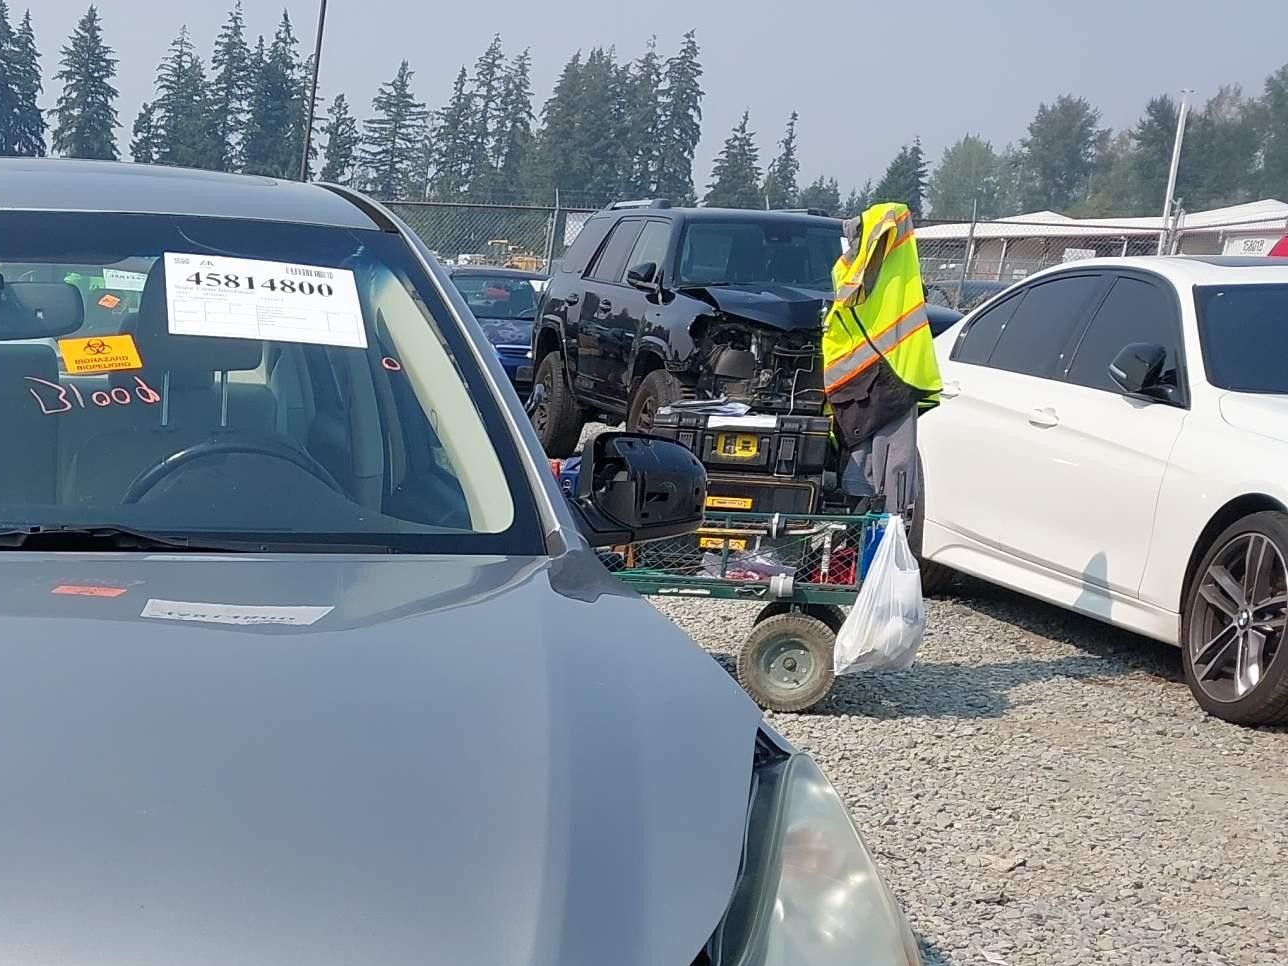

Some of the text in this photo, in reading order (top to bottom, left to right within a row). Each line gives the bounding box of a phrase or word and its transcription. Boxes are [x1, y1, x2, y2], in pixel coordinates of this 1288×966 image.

[185, 271, 334, 298] 45814800
[74, 355, 129, 365] BIOHAZARD
[76, 361, 132, 371] BIOPELIGRO
[24, 375, 161, 414] Blood
